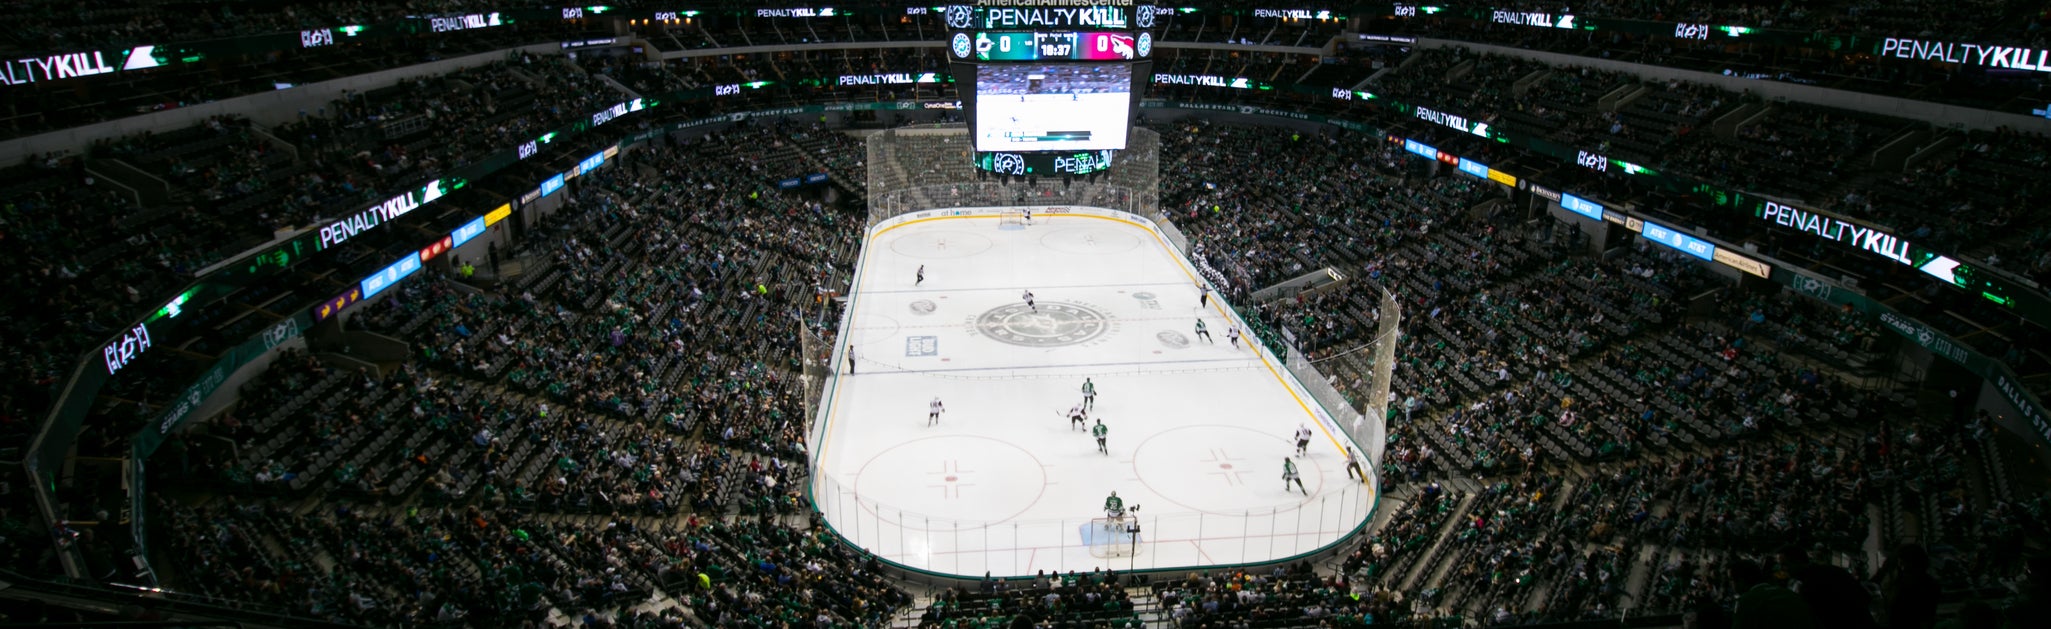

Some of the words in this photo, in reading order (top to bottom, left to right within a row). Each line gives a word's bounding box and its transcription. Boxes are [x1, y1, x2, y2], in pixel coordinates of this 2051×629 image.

[1492, 11, 1553, 28] PENALTYKILL
[1000, 36, 1010, 52] 0
[1097, 35, 1108, 52] 0
[839, 73, 914, 86] PENALTYKILL
[1154, 73, 1227, 87] PENALTYKILL
[1416, 106, 1469, 132] PENALTYKILL
[320, 191, 419, 249] PENALTYKILL
[1763, 201, 1913, 267] PENALTYKILL
